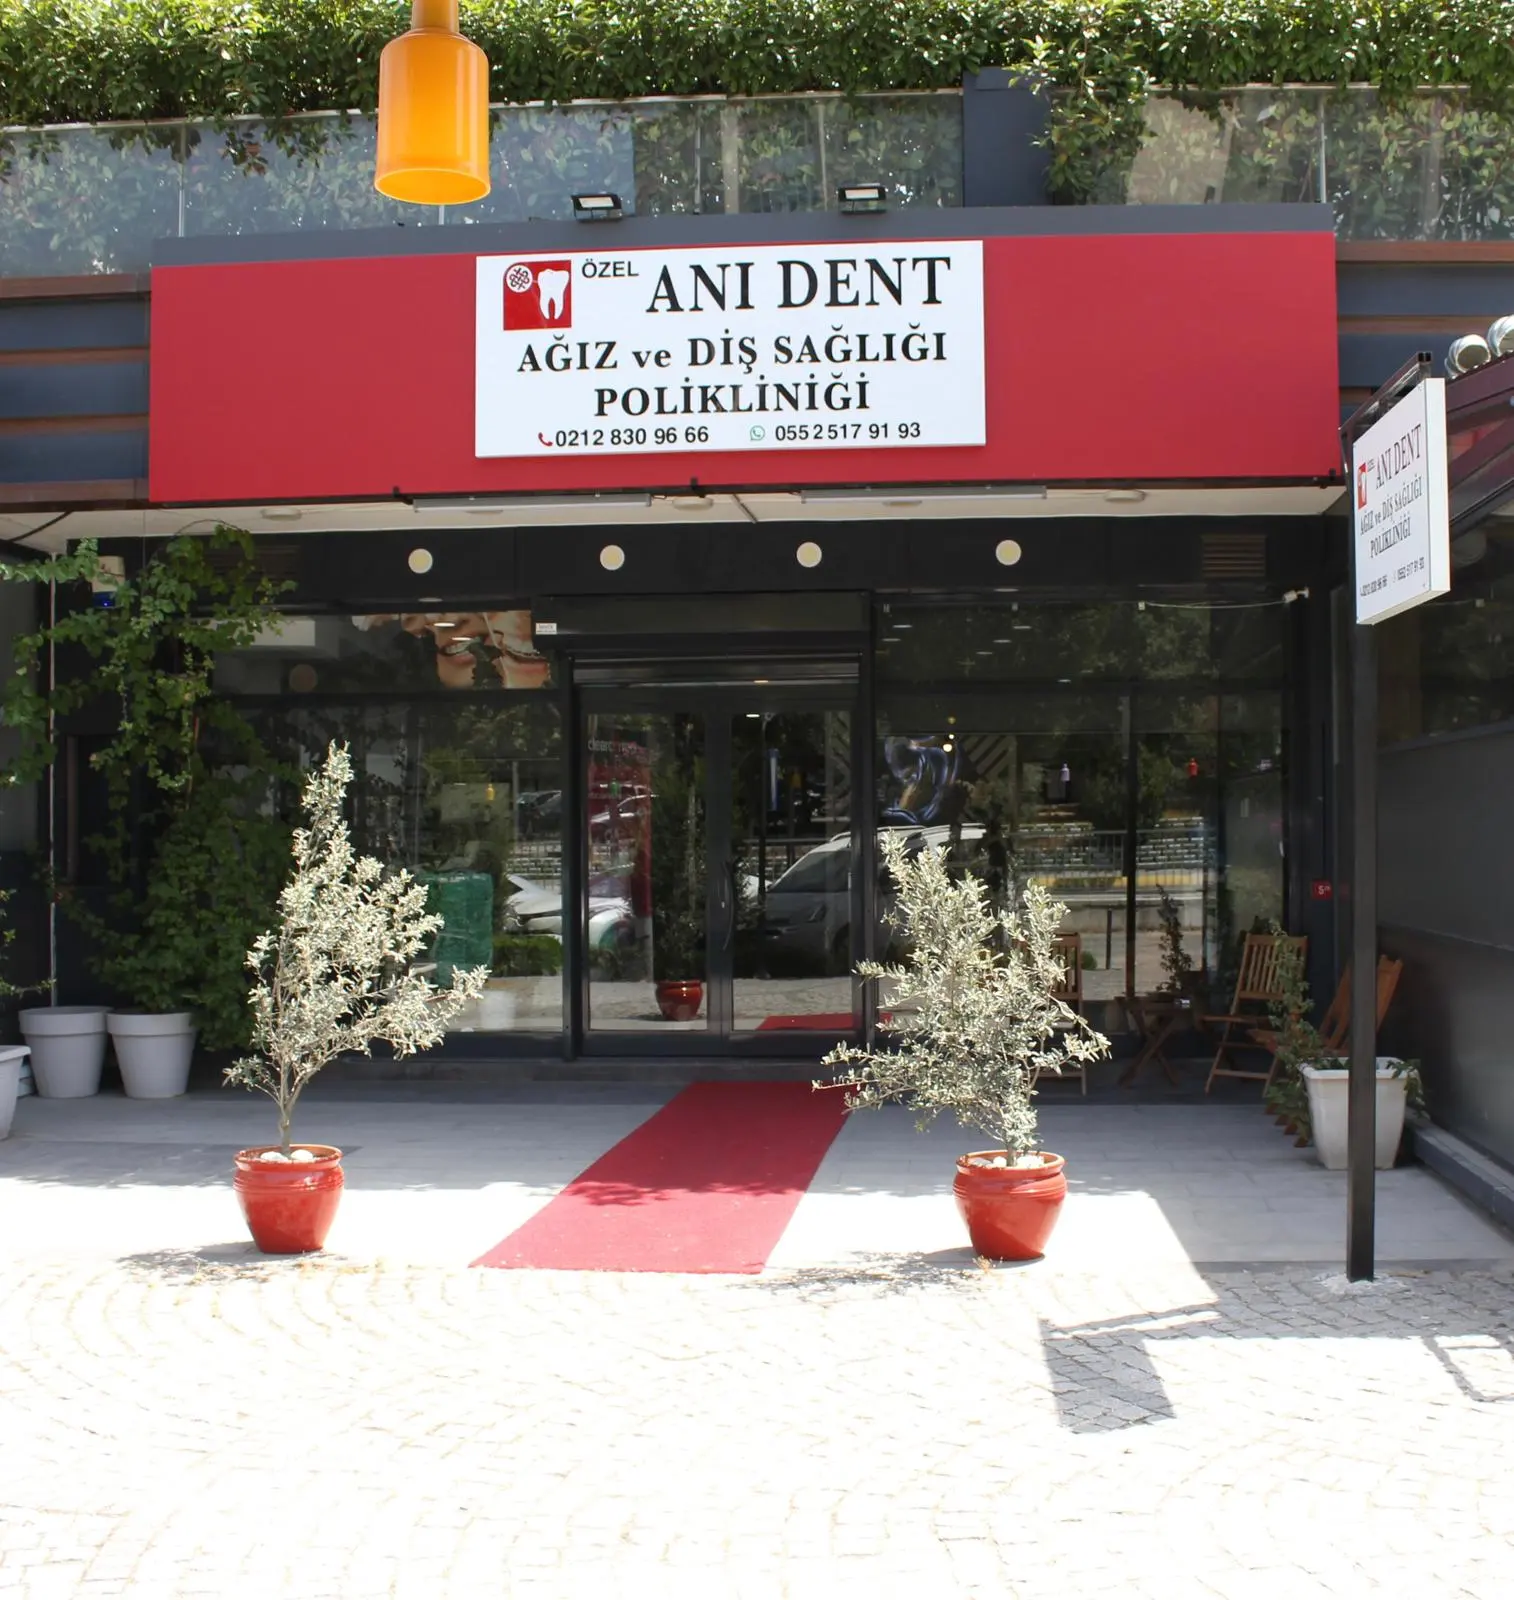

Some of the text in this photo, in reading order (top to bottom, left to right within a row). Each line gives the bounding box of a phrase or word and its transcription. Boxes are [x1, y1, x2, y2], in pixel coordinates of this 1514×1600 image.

[582, 258, 639, 279] ÖZEL
[645, 256, 951, 313] ANI DENT
[517, 323, 947, 375] AĞIZ ve DİŞ SAĞLIĞI
[594, 371, 870, 417] POLİKLİNİĞİ
[555, 425, 709, 447] 0212 830 96 66
[868, 423, 888, 440] 91
[897, 422, 921, 440] 93
[1376, 424, 1421, 489] ANI DENT
[1375, 512, 1382, 525] ve
